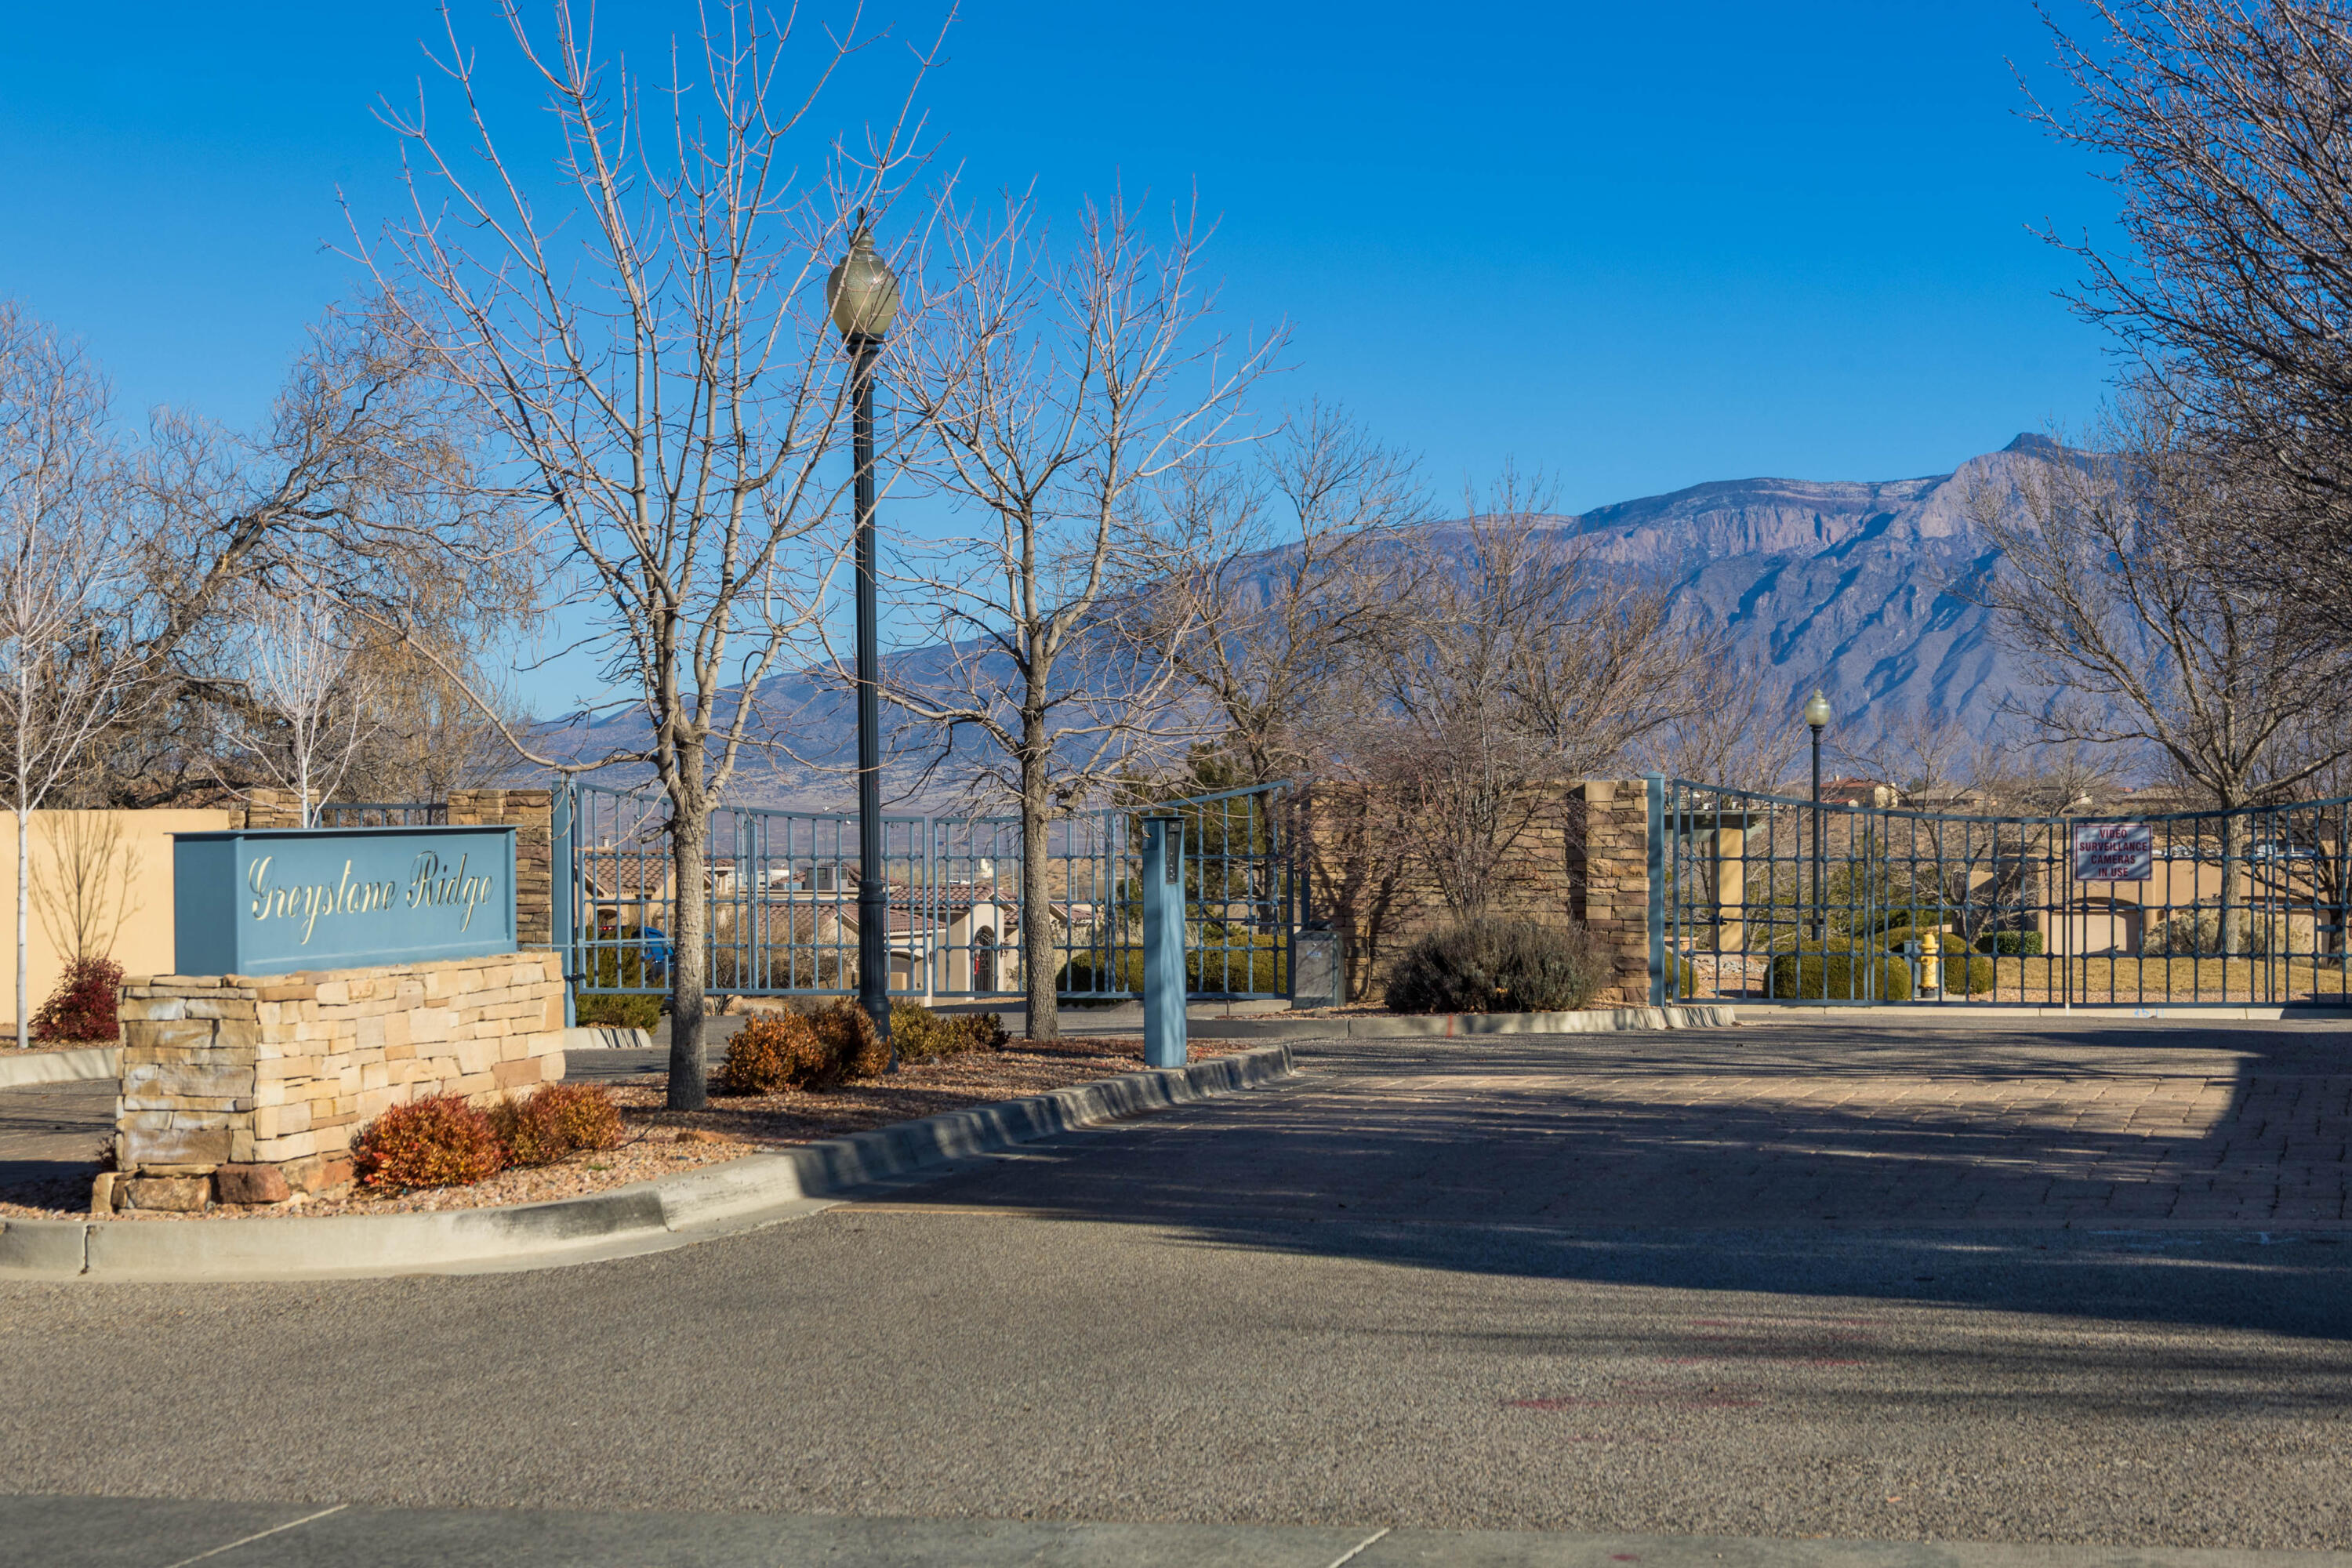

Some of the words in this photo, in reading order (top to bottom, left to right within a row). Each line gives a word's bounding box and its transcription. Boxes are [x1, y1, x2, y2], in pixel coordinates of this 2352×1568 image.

[2100, 829, 2127, 838] VIDEO
[2079, 842, 2147, 851] SURVEILLANCE
[2091, 855, 2136, 864] CAMERAS
[2098, 867, 2107, 877] IN
[2111, 867, 2129, 877] USE
[249, 855, 397, 945] Greystone
[406, 851, 494, 933] Ridge
